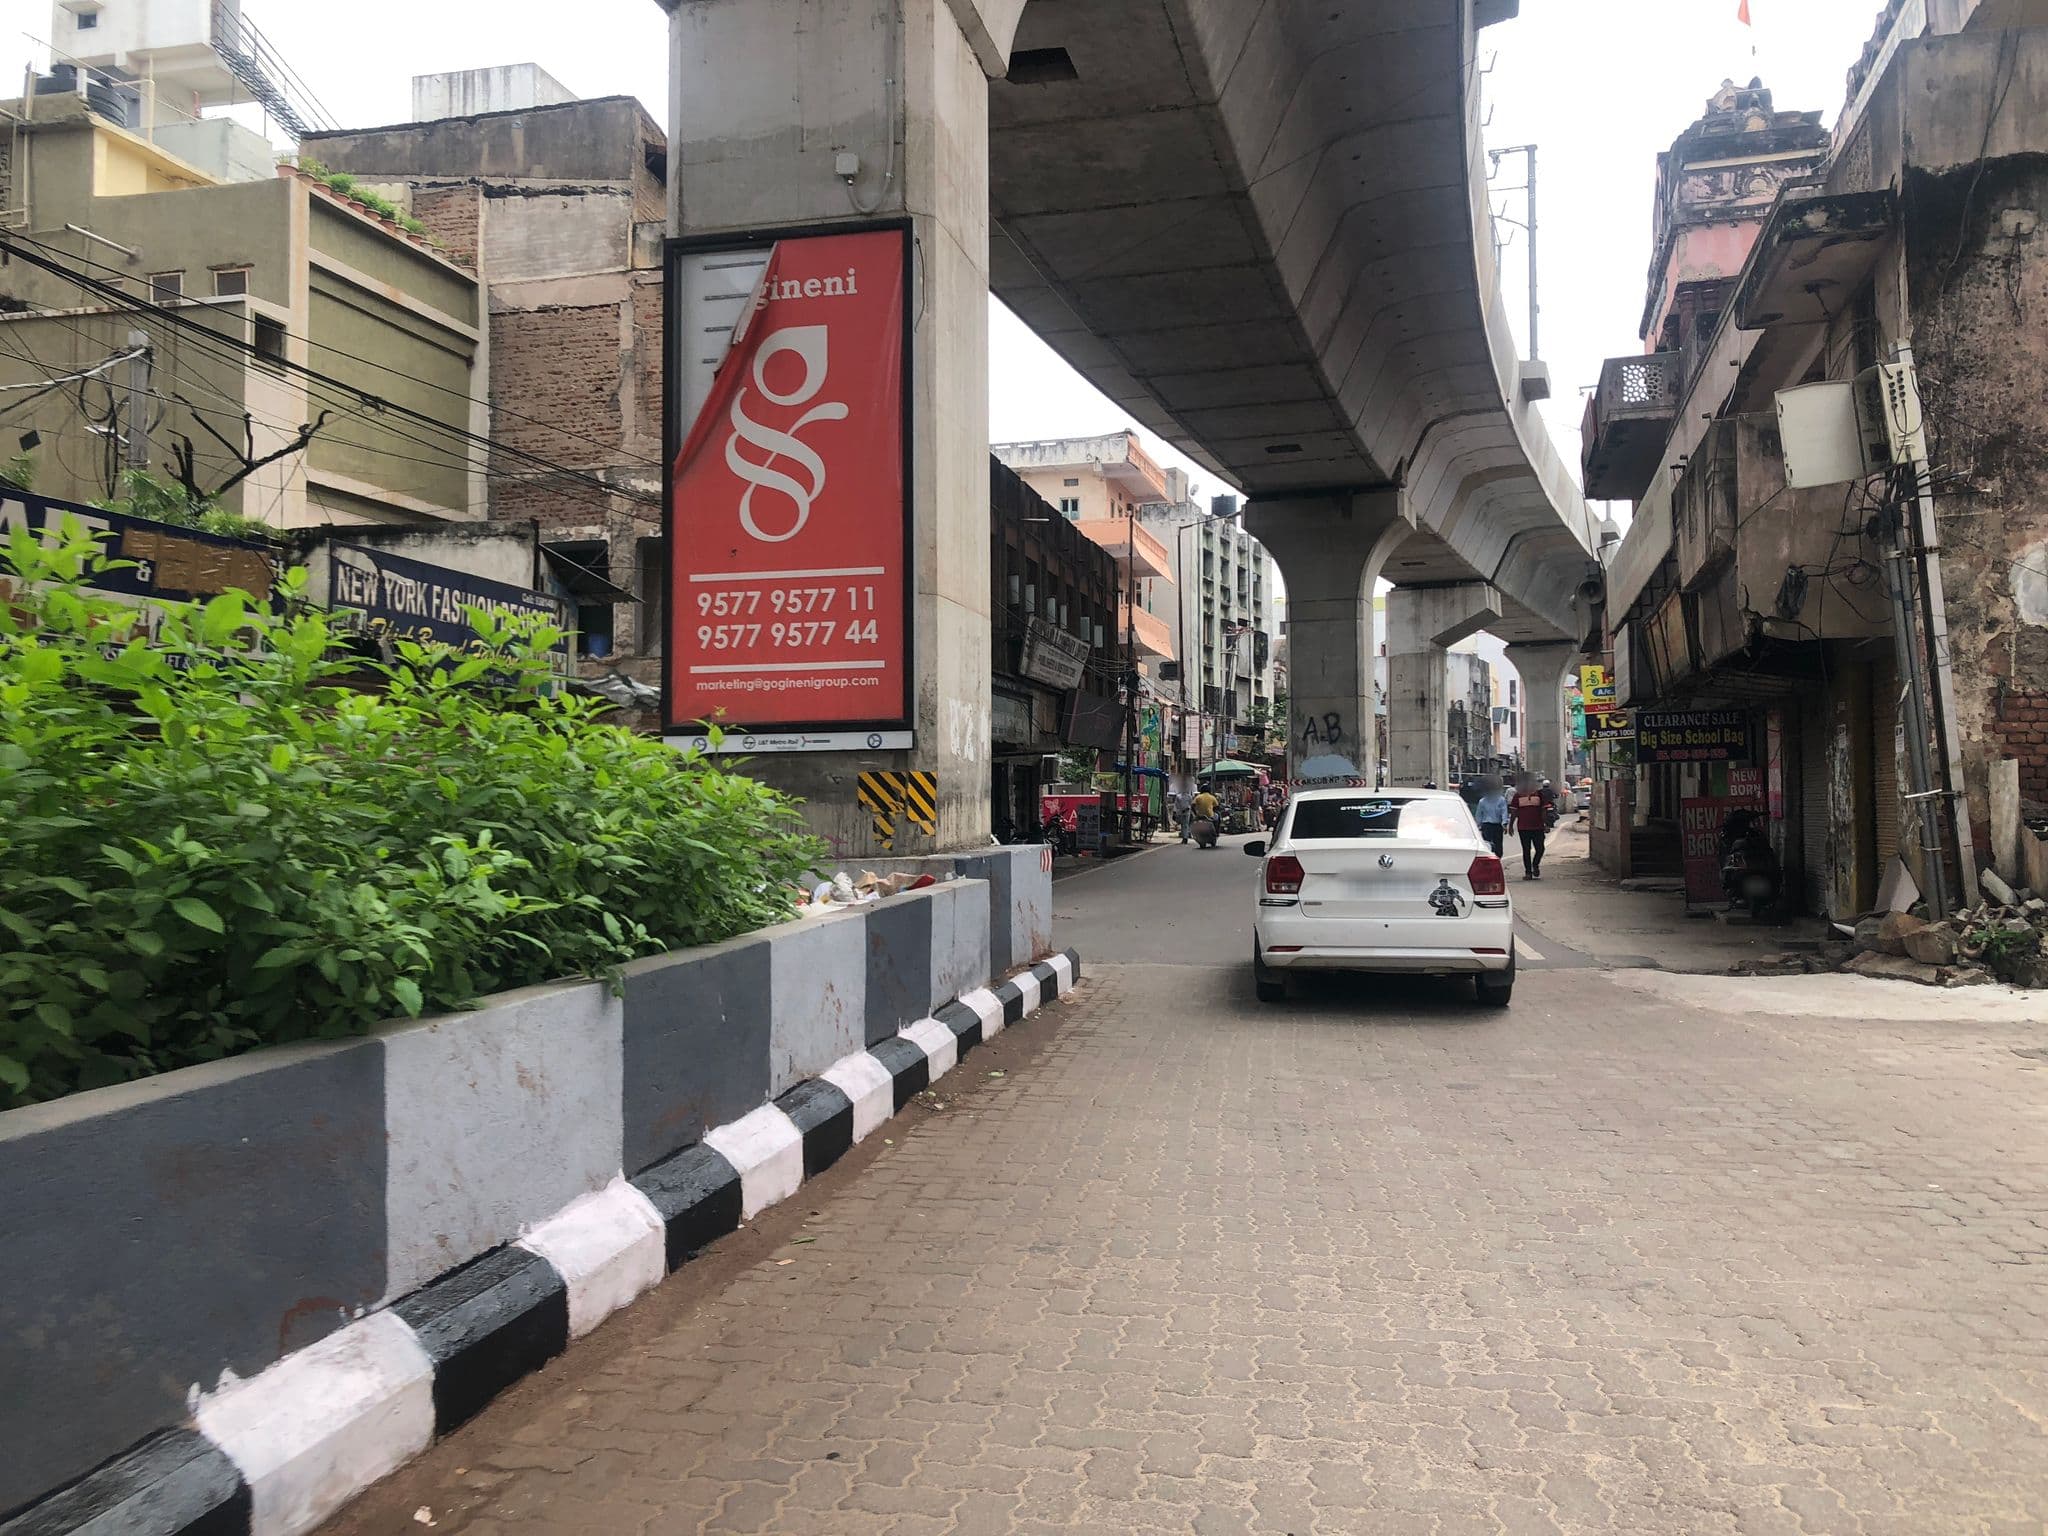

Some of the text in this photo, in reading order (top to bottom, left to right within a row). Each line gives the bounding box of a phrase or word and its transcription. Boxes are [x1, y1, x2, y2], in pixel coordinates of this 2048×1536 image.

[336, 564, 379, 608] NEW
[383, 576, 429, 618] YORK
[697, 586, 876, 617] 9577 9577 11
[697, 618, 879, 651] 9577 9577 44
[696, 674, 880, 692] marketing@goginenigroup.com
[1643, 711, 1740, 727] CLEARANCE SALE
[1591, 729, 1597, 738] 2
[1640, 727, 1745, 749] Big Size School Bag
[1731, 769, 1757, 782] NEW
[1685, 806, 1718, 831] NEW
